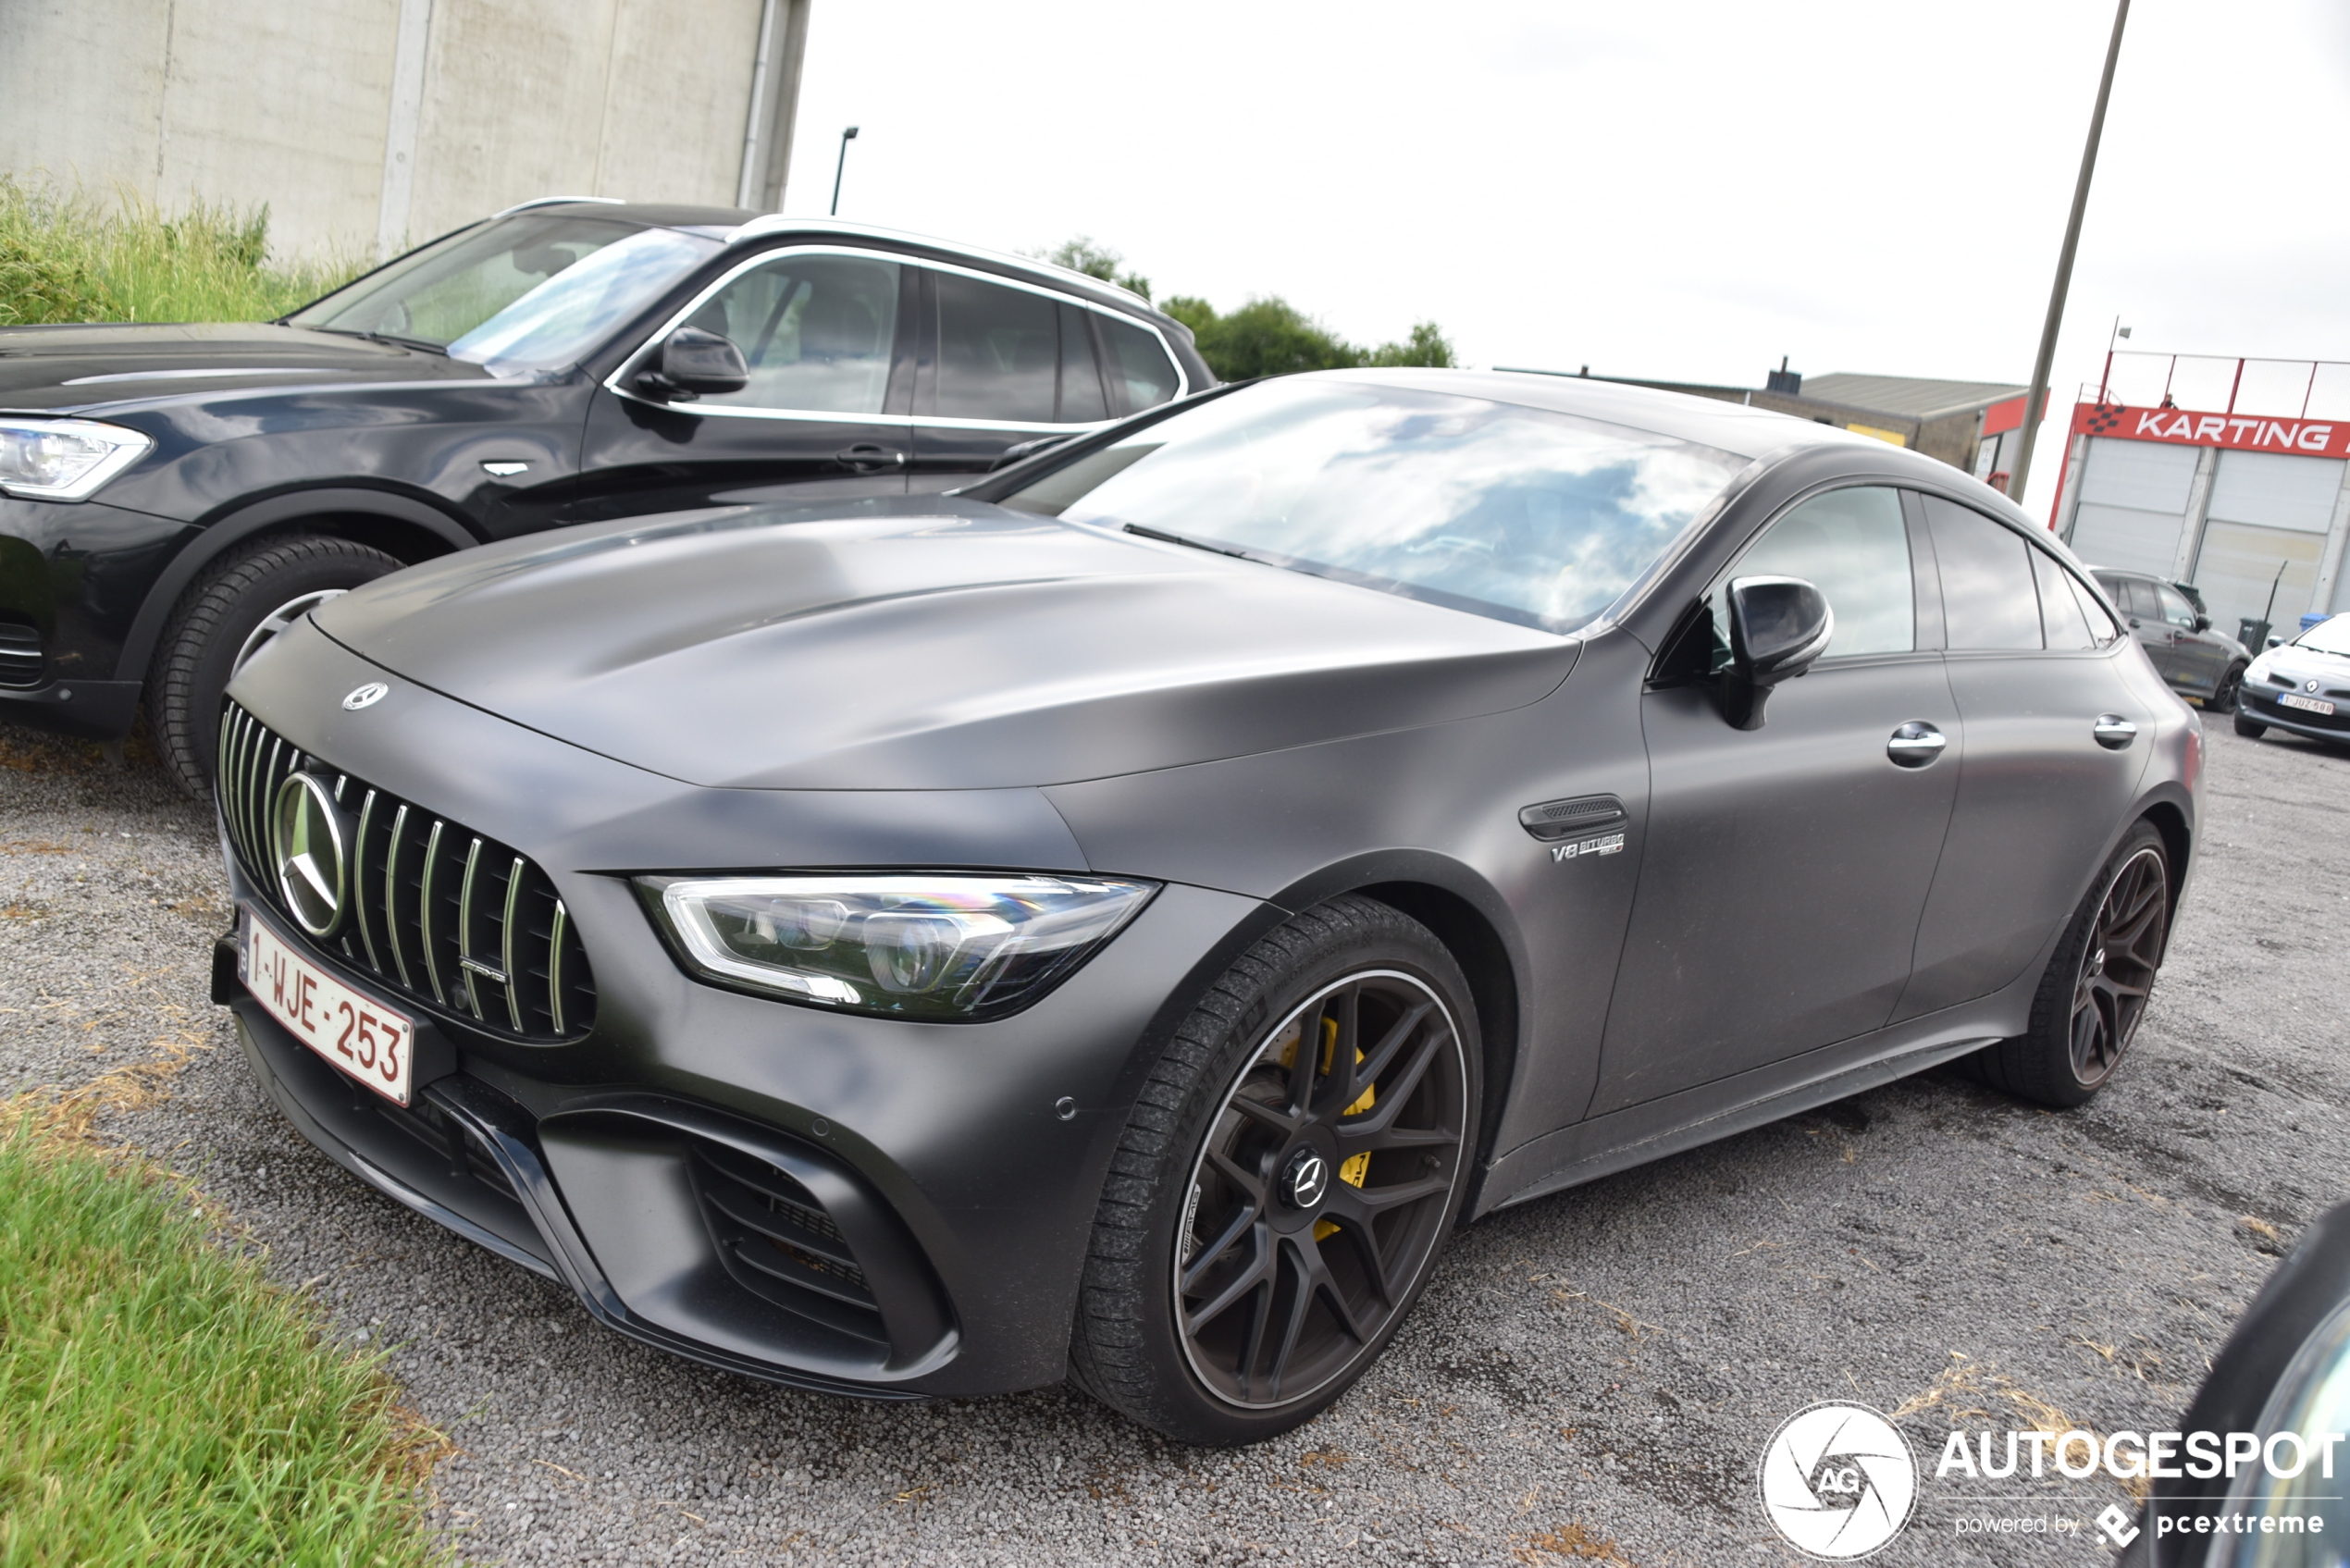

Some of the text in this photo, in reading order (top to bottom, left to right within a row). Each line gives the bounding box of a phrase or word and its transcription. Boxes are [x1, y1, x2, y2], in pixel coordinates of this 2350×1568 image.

[2135, 412, 2332, 451] KARTING
[1552, 844, 1578, 863] V8
[1579, 833, 1625, 852] BITURBO
[241, 948, 248, 972] B
[1273, 964, 1304, 995] PILOT
[1307, 943, 1342, 969] SPORT
[252, 932, 401, 1083] 1-WJE-253
[1167, 1005, 1263, 1167] MICHELIN
[1186, 1191, 1200, 1235] AMG
